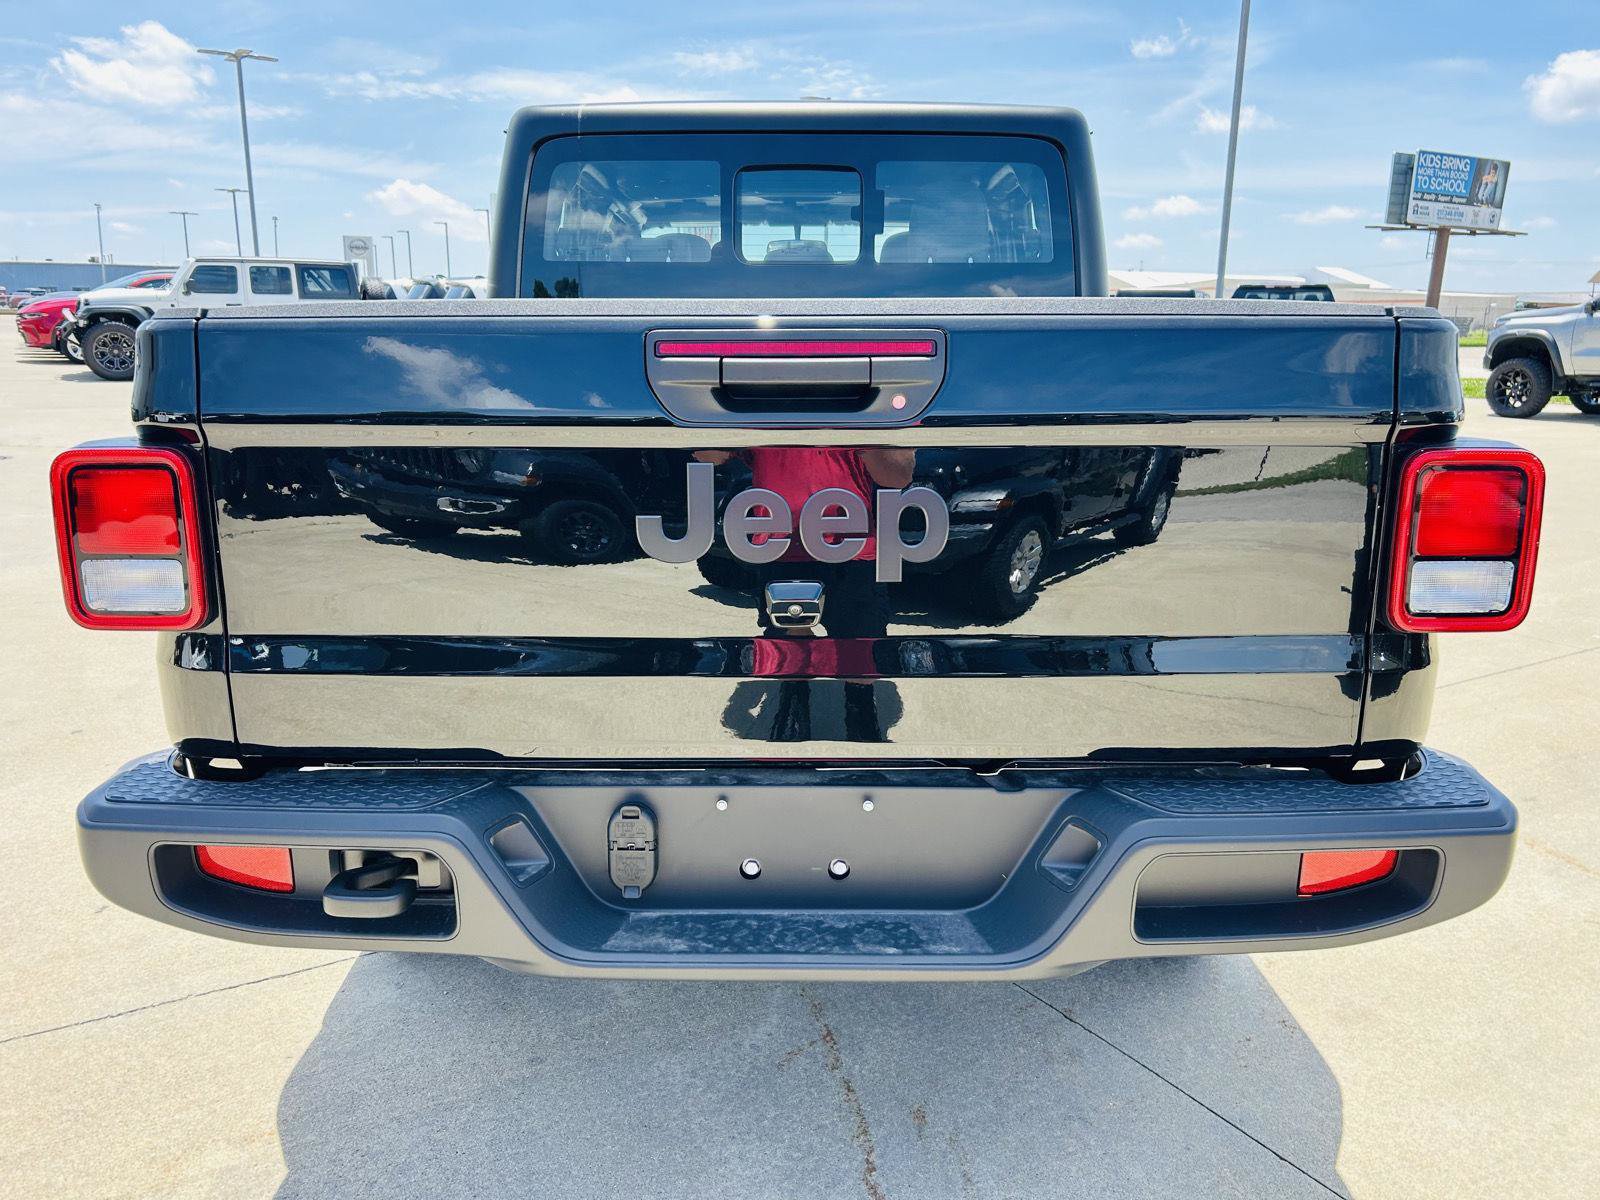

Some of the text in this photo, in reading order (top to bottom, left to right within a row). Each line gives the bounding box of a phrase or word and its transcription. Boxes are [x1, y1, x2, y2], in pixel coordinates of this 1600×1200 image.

[1419, 153, 1470, 172] KIDS BRING
[1418, 167, 1468, 181] MORE THAN BOOKS
[1418, 175, 1466, 193] TO SCHOOL
[635, 462, 950, 583] Jeep
